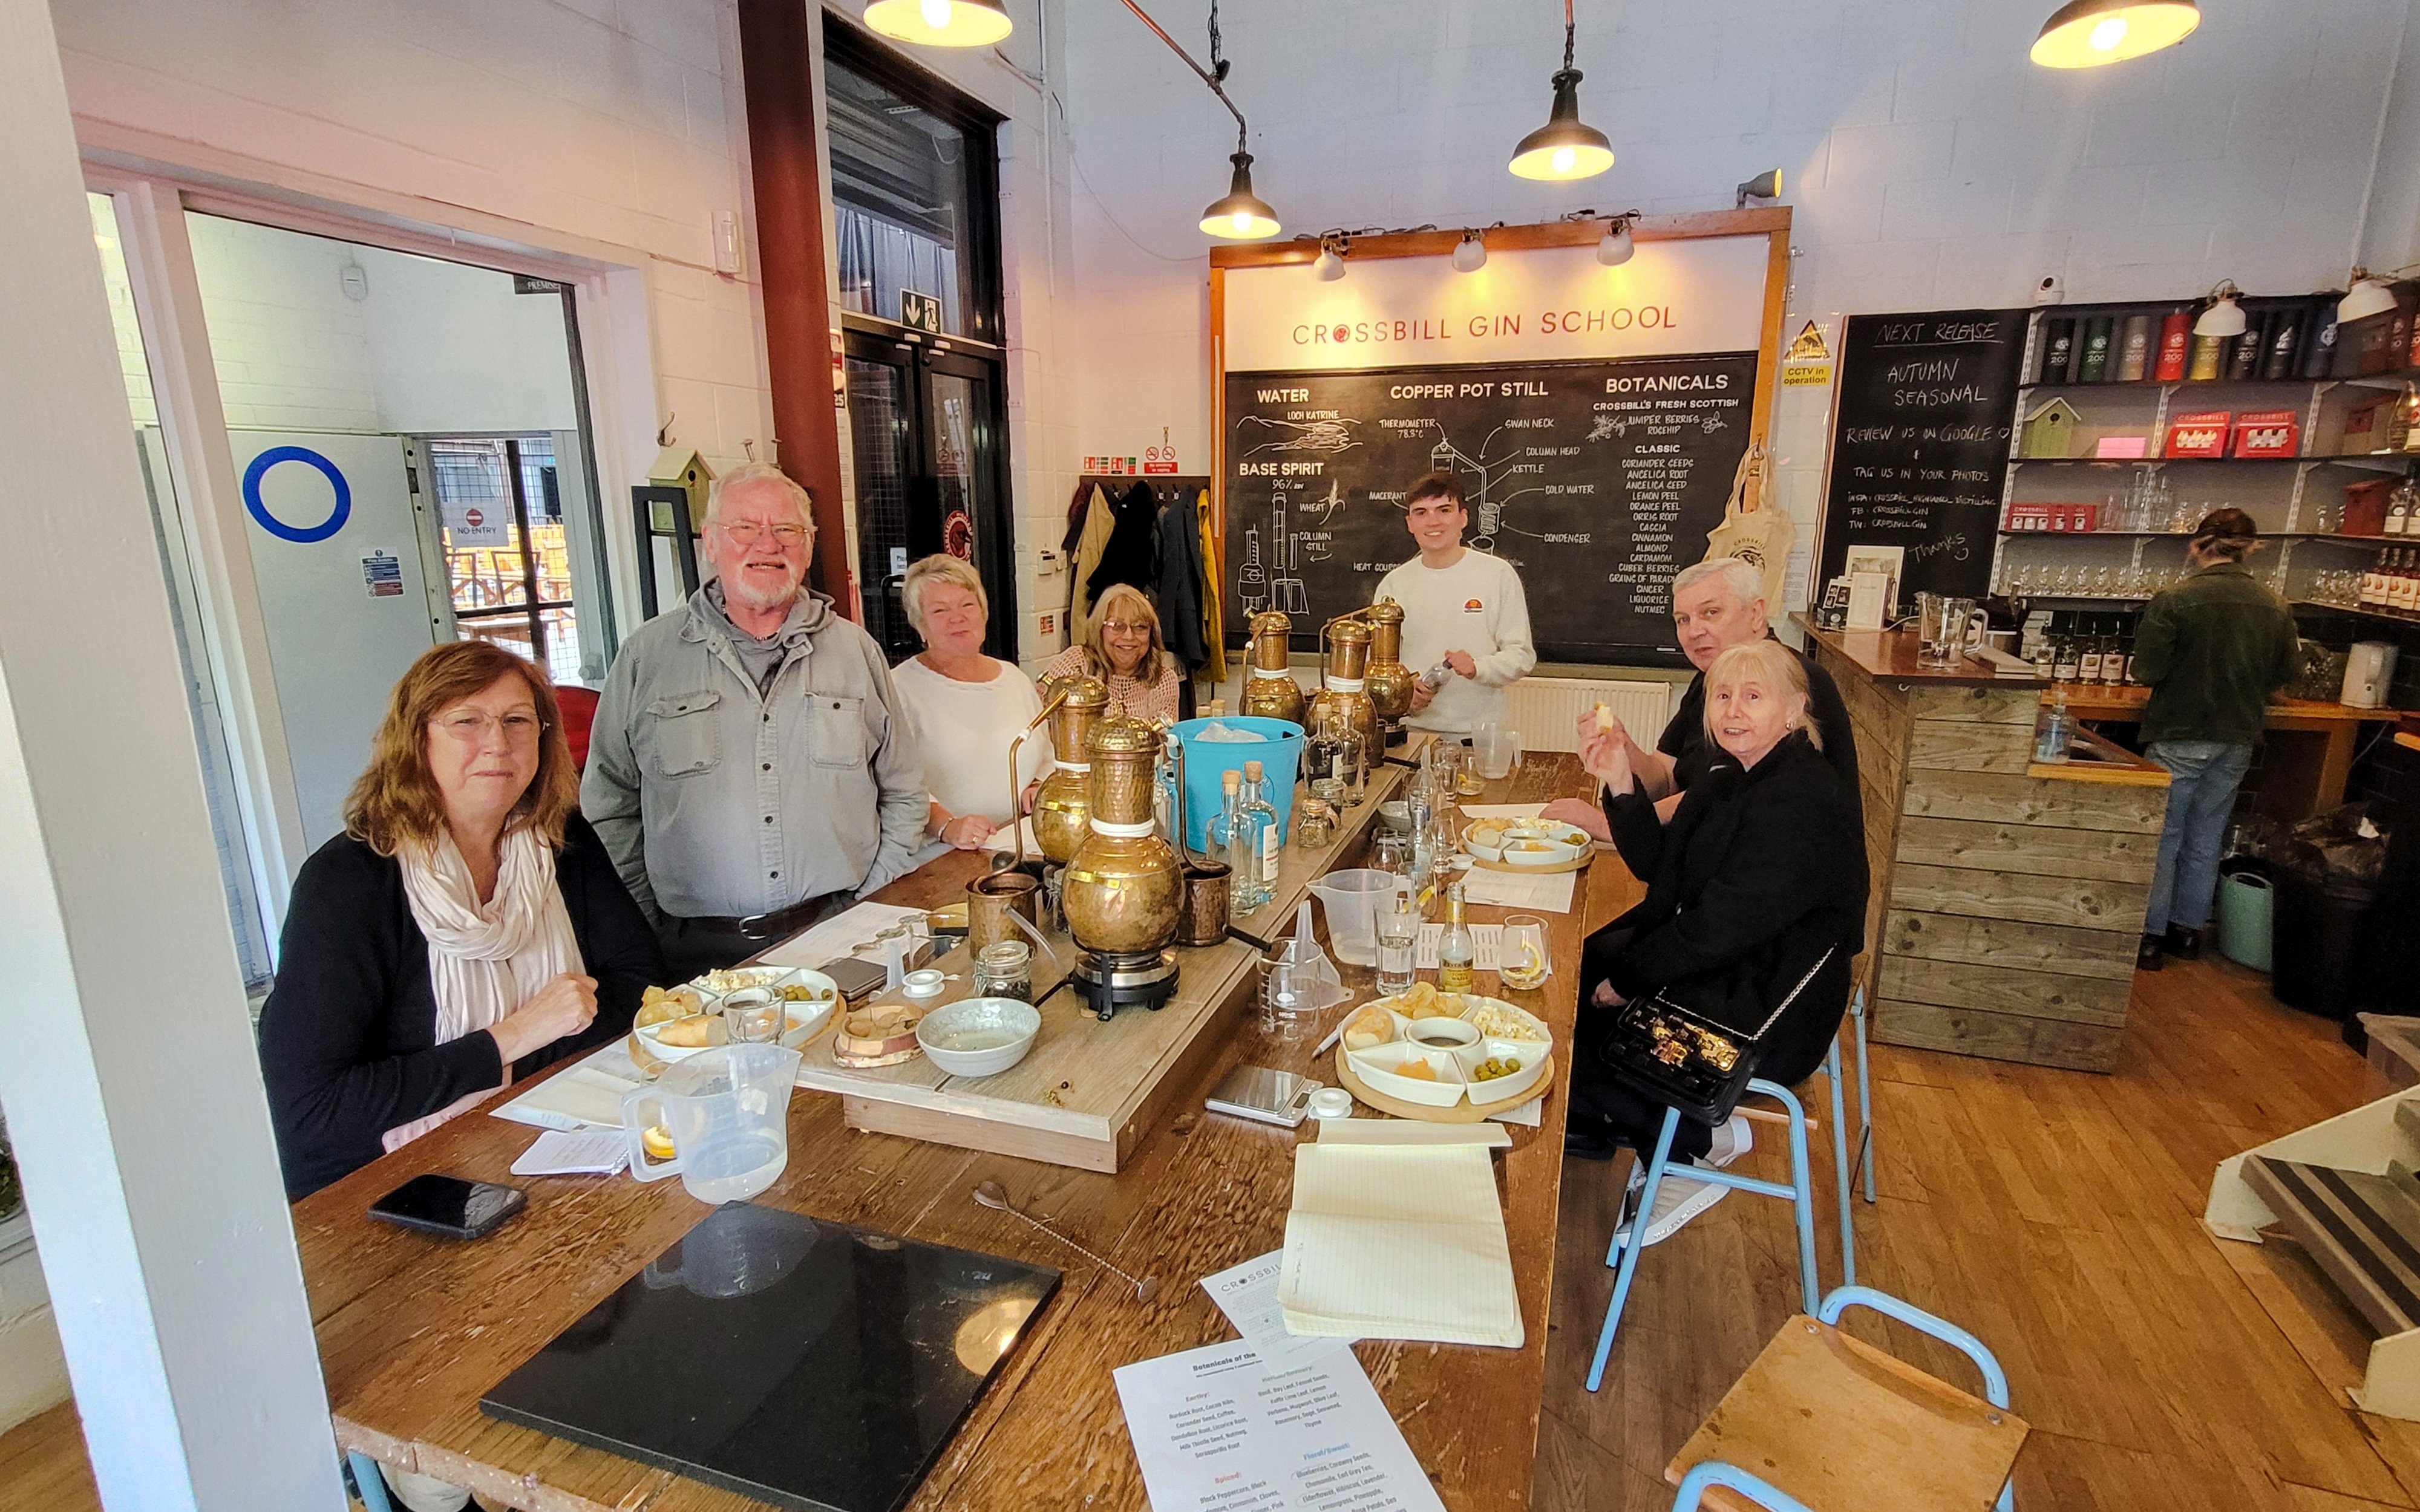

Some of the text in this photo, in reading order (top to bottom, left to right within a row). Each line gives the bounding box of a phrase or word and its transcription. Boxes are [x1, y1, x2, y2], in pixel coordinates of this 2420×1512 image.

[1293, 307, 1676, 345] CROSSBILL GIN SCHOOL
[1876, 322, 1999, 342] NEXT RELEASE
[1887, 359, 1960, 383] AUTUMN
[1606, 374, 1728, 393] BOTANICALS
[1784, 376, 1826, 386] operation
[1390, 381, 1549, 399] COPPER POT STILL
[1894, 384, 1988, 406] SEASONAL
[1257, 389, 1309, 403] WATER
[1593, 399, 1739, 411] CROSSBILL'S FRESH SCOTTISH
[1287, 410, 1339, 420] LOCH KATRINE
[1627, 414, 1699, 425] JUNIPER BERRIES
[1379, 418, 1436, 429] THERMOMETER
[1505, 418, 1554, 429] SWAN NECK
[1647, 425, 1681, 435] ROSEHIP
[1846, 425, 1894, 443] REVIEW
[1902, 427, 1915, 438] US
[1940, 423, 1992, 442] GOOGLE
[1526, 446, 1580, 457] COLUMN HEAD
[1635, 445, 1681, 454] CLASSIC
[1621, 458, 1694, 468] CORIANDER SEEDS
[1240, 462, 1324, 476] BASE SPIRIT
[1513, 464, 1545, 474] KETTLE
[1627, 469, 1689, 479] ANGELICA ROOT
[1853, 466, 1989, 482] TAG US IN YOUR PHOTOS
[1272, 479, 1292, 490] 96%
[1545, 484, 1595, 495] COLD WATER
[1626, 481, 1687, 490] ANGELICA SEED
[1369, 491, 1407, 501] MACERANT
[1632, 491, 1679, 501] LEMON PEEL
[1300, 503, 1326, 513] WHEAT
[1629, 502, 1681, 511] ORANGE PEEL
[1633, 512, 1679, 521] ORRIS ROOT
[1300, 532, 1332, 541] COLUMN
[1544, 533, 1591, 544] CONDENSER
[1632, 533, 1674, 542] CINNAMON
[1306, 543, 1327, 552] STILL
[1636, 544, 1669, 553] ALMOND
[1630, 553, 1673, 562] CARDAMOM
[1353, 561, 1373, 572] HEAT
[1646, 564, 1680, 573] BERRIES
[1609, 573, 1647, 583] GRAINS OF
[1636, 585, 1664, 594] GINGER
[1629, 595, 1670, 604] LIQUORICE
[1634, 605, 1666, 614] NUTMEG
[1192, 1358, 1233, 1372] Botanicals
[1214, 1471, 1242, 1484] Spiced:
